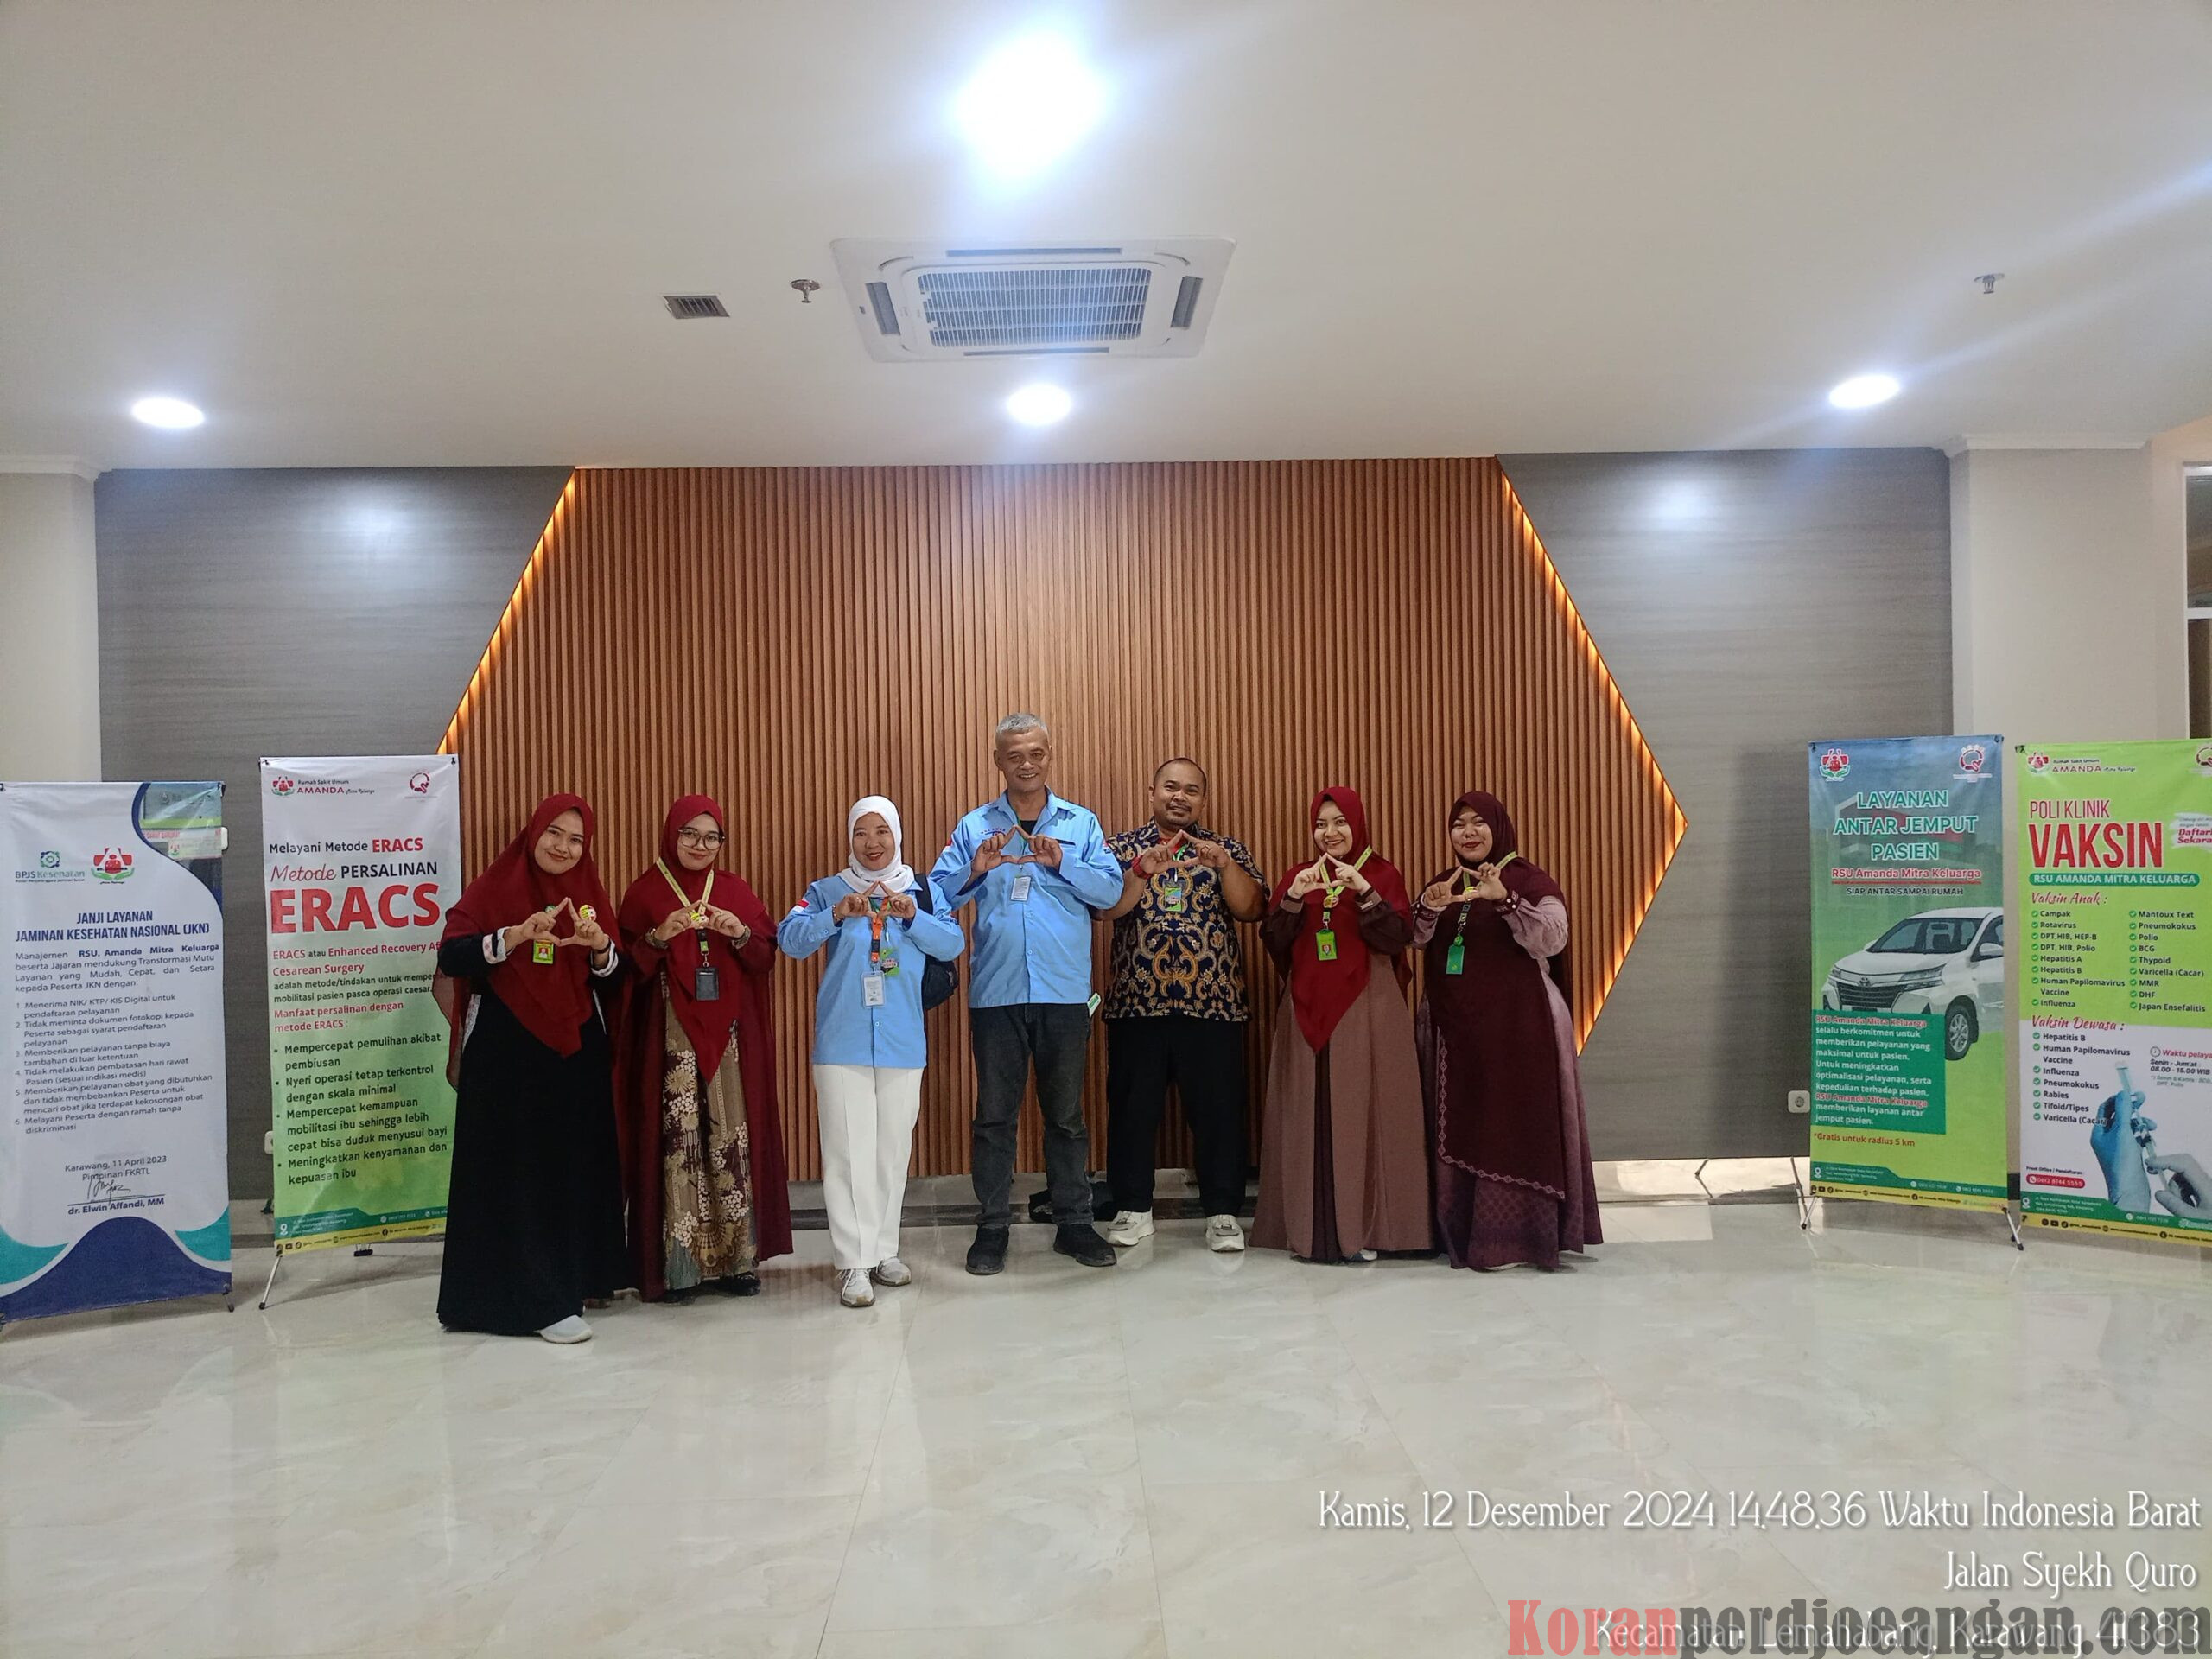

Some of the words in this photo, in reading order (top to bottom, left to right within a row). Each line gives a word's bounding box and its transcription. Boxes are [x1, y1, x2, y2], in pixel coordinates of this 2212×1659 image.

[1857, 790, 1948, 809] LAYANAN
[2031, 801, 2059, 818] POLI
[2064, 800, 2110, 818] KLINIK
[1833, 817, 1898, 835] ANTAR
[1901, 816, 1978, 833] JEMPUT
[270, 842, 321, 855] Melayani
[326, 842, 368, 852] Metode
[372, 838, 423, 853] ERACS
[1872, 842, 1938, 861] PASIEN
[2029, 823, 2162, 868] VAKSIN
[270, 864, 336, 882] Metode
[341, 862, 437, 879] PERSALINAN
[1832, 868, 1853, 878] RSU
[1856, 868, 1898, 878] Amanda
[1901, 868, 1929, 878] Mitra
[1933, 868, 1980, 880] Keluarga
[2140, 875, 2196, 884] KELUARGA
[2032, 893, 2067, 904] Vaksin
[2070, 892, 2100, 904] Anak
[270, 883, 440, 934] ERACS
[77, 912, 104, 924] JANJI
[107, 911, 152, 923] LAYANAN
[16, 931, 63, 942] JAMINAN
[67, 928, 128, 940] KESEHATAN
[130, 925, 180, 937] NASIONAL
[183, 923, 209, 934] (JKN)
[16, 951, 67, 961] Manajemen
[105, 948, 142, 957] Amanda
[181, 944, 219, 952] Keluarga
[273, 950, 305, 959] ERACS
[328, 945, 378, 957] Enhanced
[381, 943, 426, 954] Recovery
[16, 963, 48, 971] beserta
[51, 962, 81, 970] Jajaran
[85, 958, 136, 968] mendukung
[273, 966, 321, 976] Cesarean
[325, 963, 365, 974] Surgery
[2070, 979, 2125, 988] Papilomavirus
[274, 1008, 315, 1018] Manfaat
[317, 1005, 366, 1016] persalinan
[370, 1001, 404, 1013] dengan
[2032, 1015, 2069, 1027] Vaksin
[2073, 1016, 2116, 1031] Dewasa
[285, 1042, 353, 1054] Mempercepat
[357, 1037, 407, 1048] pemulihan
[411, 1034, 441, 1043] akibat
[1816, 1038, 1866, 1047] memberikan
[1867, 1040, 1908, 1050] pelayanan
[1910, 1042, 1930, 1052] yang
[2074, 1046, 2130, 1056] Papilomavirus
[2189, 1051, 2212, 1059] pelaya
[285, 1058, 340, 1071] pembiusan
[1842, 1062, 1899, 1072] meningkatkan
[2044, 1068, 2079, 1077] Influenza
[286, 1076, 311, 1088] Nyeri
[315, 1072, 352, 1084] operasi
[356, 1069, 383, 1080] tetap
[387, 1065, 434, 1077] terkontrol
[2044, 1079, 2099, 1090] Pneumokokus
[286, 1091, 324, 1104] dengan
[328, 1088, 355, 1098] skala
[359, 1084, 396, 1096] minimal
[287, 1105, 356, 1120] Mempercepat
[359, 1098, 417, 1112] kemampuan
[2044, 1103, 2089, 1112] Tifoid/Tipes
[288, 1122, 336, 1135] mobilitasi
[340, 1121, 355, 1130] ibu
[359, 1117, 402, 1129] sehingga
[405, 1113, 429, 1122] lebih
[288, 1141, 317, 1153] cepat
[321, 1138, 341, 1147] bisa
[346, 1134, 375, 1145] duduk
[378, 1129, 424, 1142] menyusui
[428, 1126, 448, 1137] bayi
[1842, 1135, 1866, 1143] untuk
[1868, 1136, 1893, 1145] radius
[289, 1153, 359, 1168] Meningkatkan
[364, 1145, 425, 1160] kenyamanan
[429, 1143, 447, 1152] dan
[65, 1163, 110, 1173] Karawang,
[124, 1158, 144, 1167] April
[289, 1172, 339, 1185] kepuasan
[342, 1169, 356, 1178] ibu
[83, 1204, 107, 1213] Elwin
[110, 1200, 145, 1211] Affandi,
